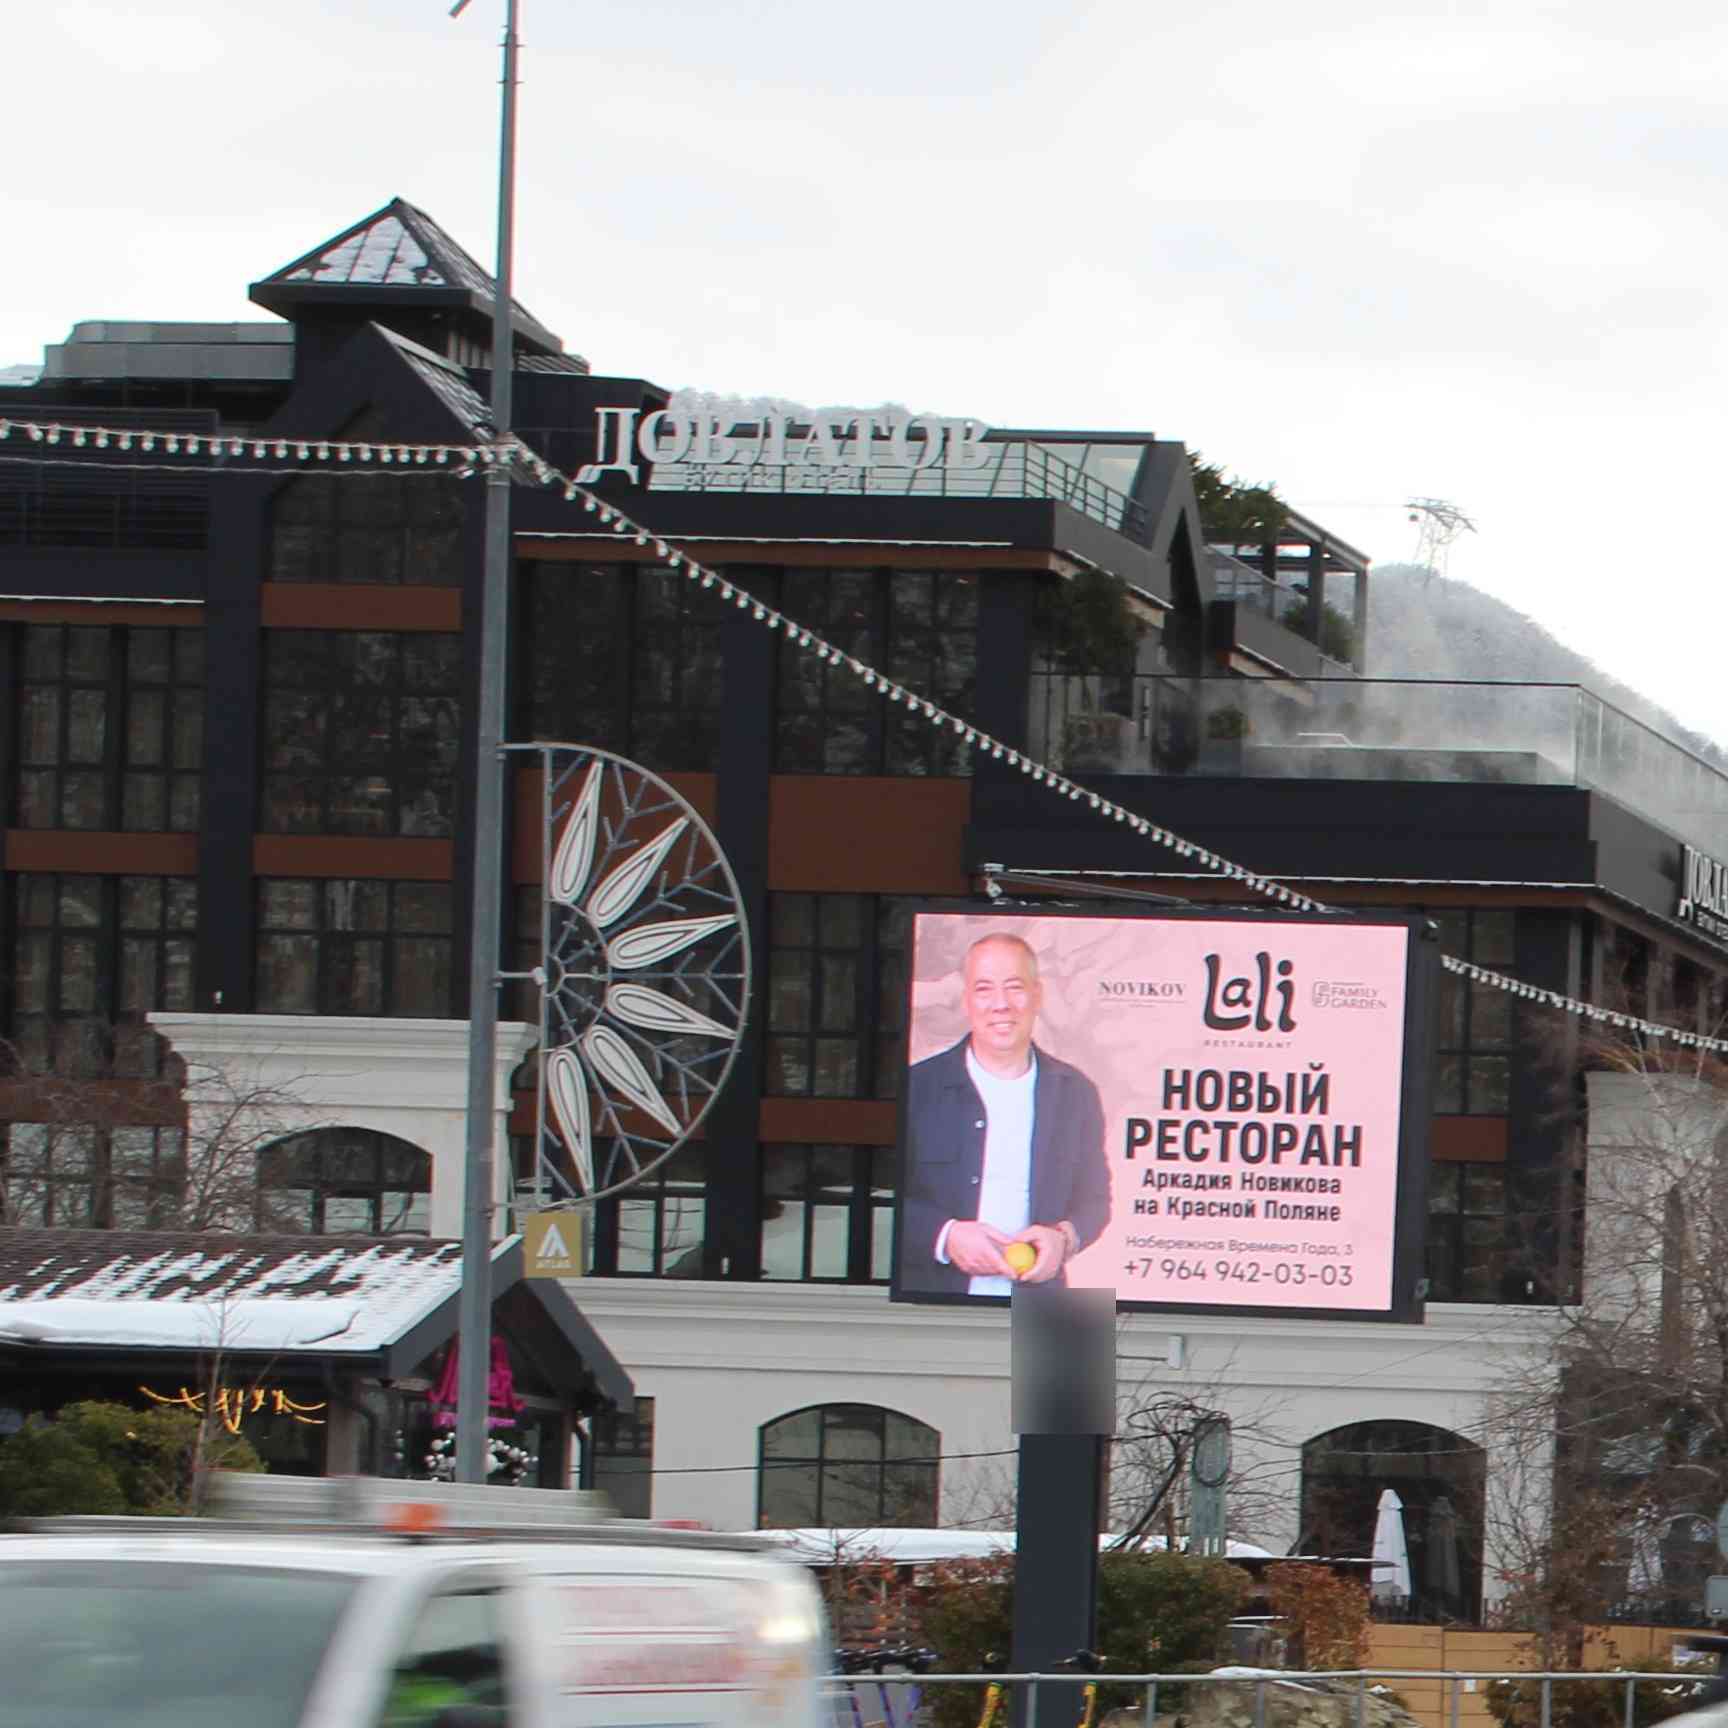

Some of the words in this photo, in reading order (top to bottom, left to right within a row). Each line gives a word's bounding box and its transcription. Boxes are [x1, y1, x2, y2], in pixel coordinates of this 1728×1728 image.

[575, 406, 992, 484] ДОВЛАТОВ
[1099, 981, 1186, 997] NOVIKOV
[1203, 951, 1296, 1033] Lali
[1331, 986, 1379, 998] FAMILY
[1331, 998, 1387, 1010] GARDEN
[1202, 1039, 1293, 1049] RESTAURANT
[1163, 1062, 1330, 1115] НОВЫЙ
[1126, 1118, 1362, 1167] РЕСТОРАН
[1143, 1169, 1232, 1192] Аркадия
[1240, 1172, 1342, 1194] Новикова
[1134, 1199, 1158, 1215] на
[1167, 1197, 1256, 1220] Красной
[1264, 1200, 1341, 1222] Поляне
[1125, 1236, 1225, 1251] Набережная
[1228, 1239, 1298, 1254] Времена
[1124, 1258, 1153, 1279] +7
[1160, 1259, 1206, 1281] 964
[1215, 1261, 1353, 1287] 942-03-03
